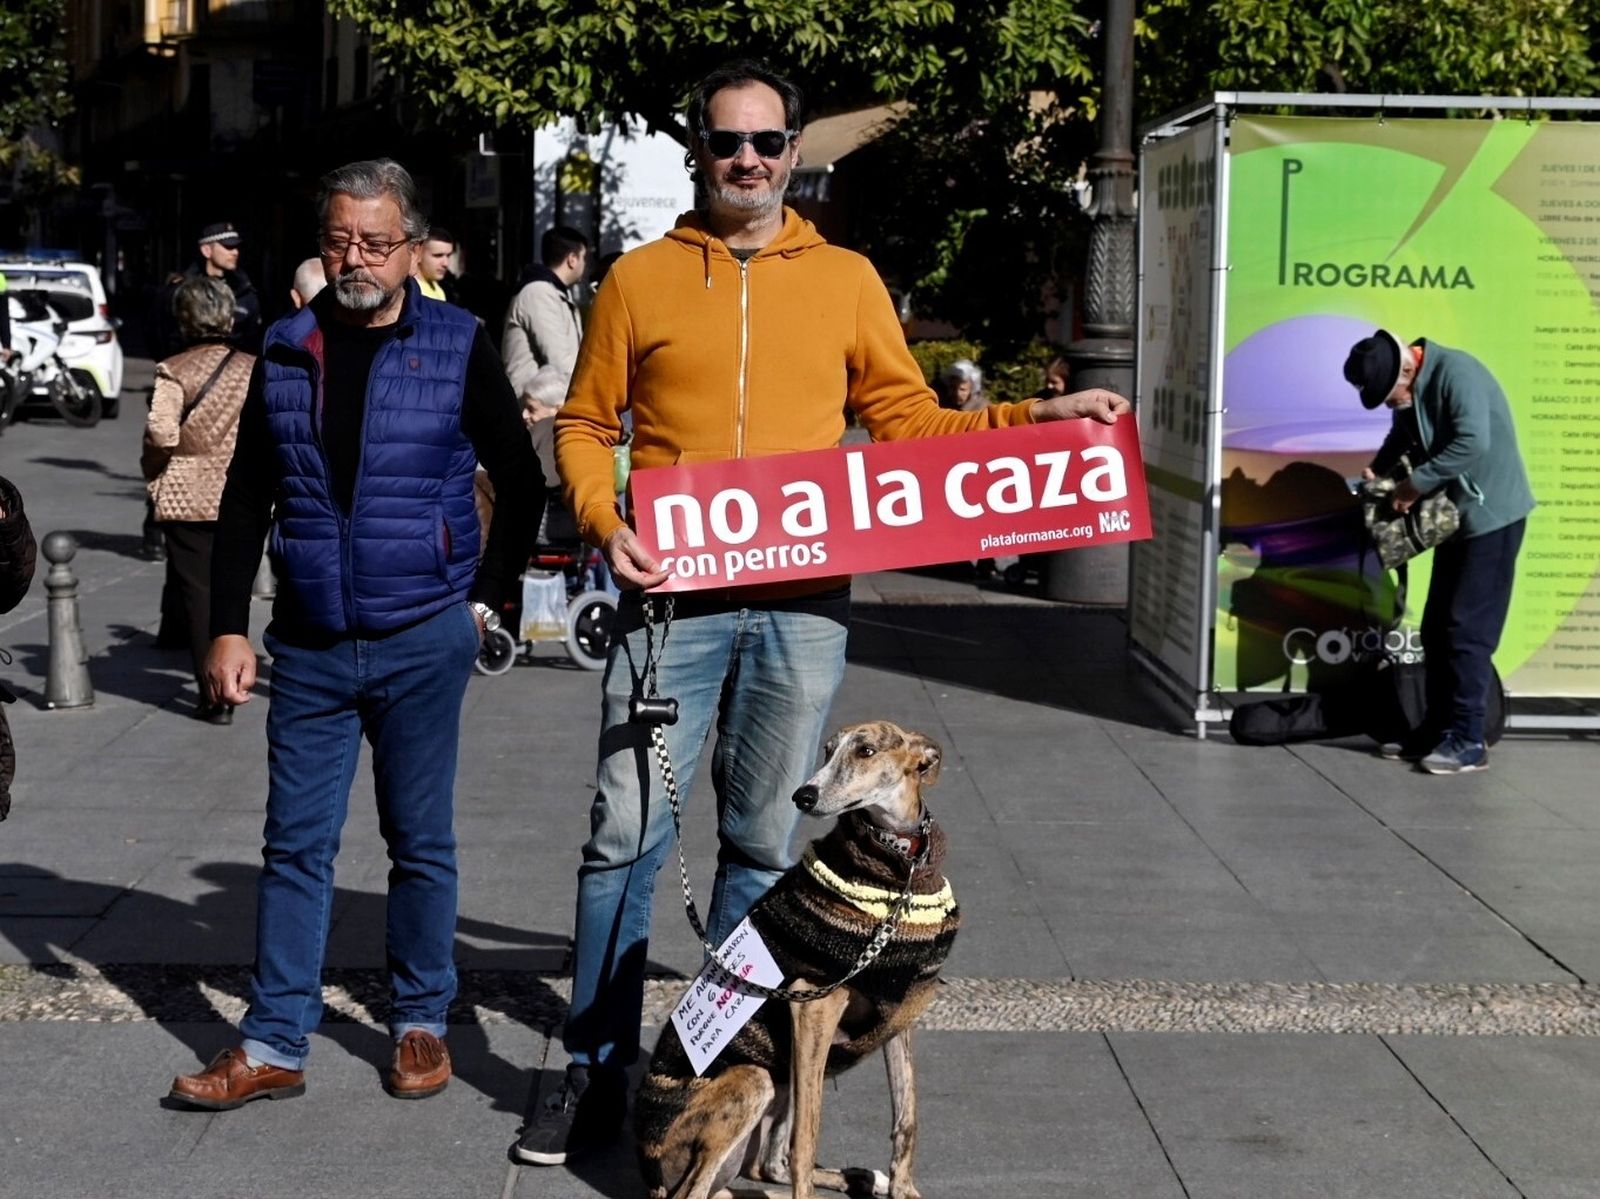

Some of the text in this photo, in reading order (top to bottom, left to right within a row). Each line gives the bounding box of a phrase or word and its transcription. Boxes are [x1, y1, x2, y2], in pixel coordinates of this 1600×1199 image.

[1278, 158, 1475, 290] PROGRAMA
[653, 445, 1128, 551] no a la caza
[980, 525, 1093, 551] plataformanac.org
[1098, 509, 1131, 533] NAC
[660, 541, 828, 581] con perros
[1283, 626, 1424, 664] Córdob
[678, 993, 696, 1020] ME
[686, 1008, 704, 1031] CON
[707, 987, 716, 1002] 6
[701, 1027, 724, 1054] PARA
